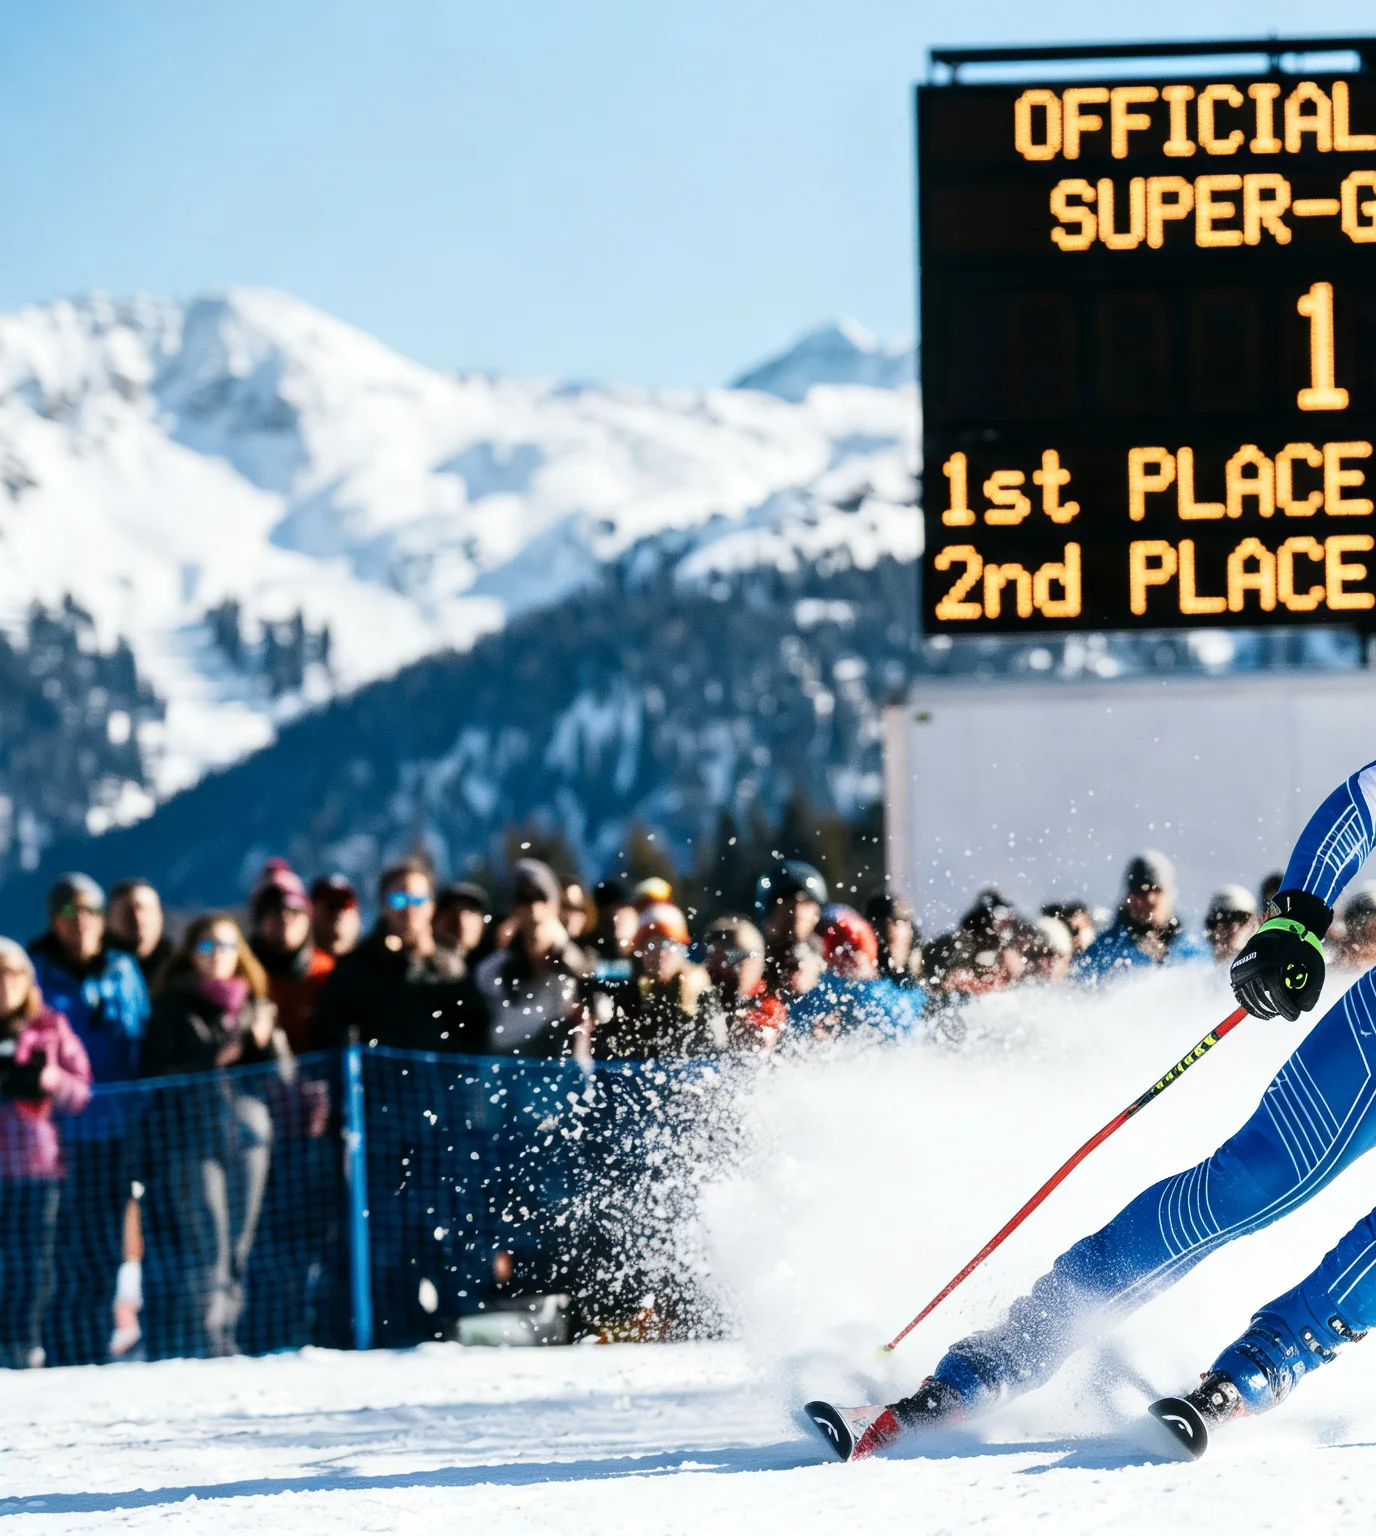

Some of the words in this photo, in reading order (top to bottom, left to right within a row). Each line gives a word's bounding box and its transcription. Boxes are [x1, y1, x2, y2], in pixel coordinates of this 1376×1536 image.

[942, 450, 1080, 526] 1st
[1128, 441, 1374, 521] PLACE
[934, 542, 1081, 620] 2nd
[1129, 535, 1375, 615] PLACE
